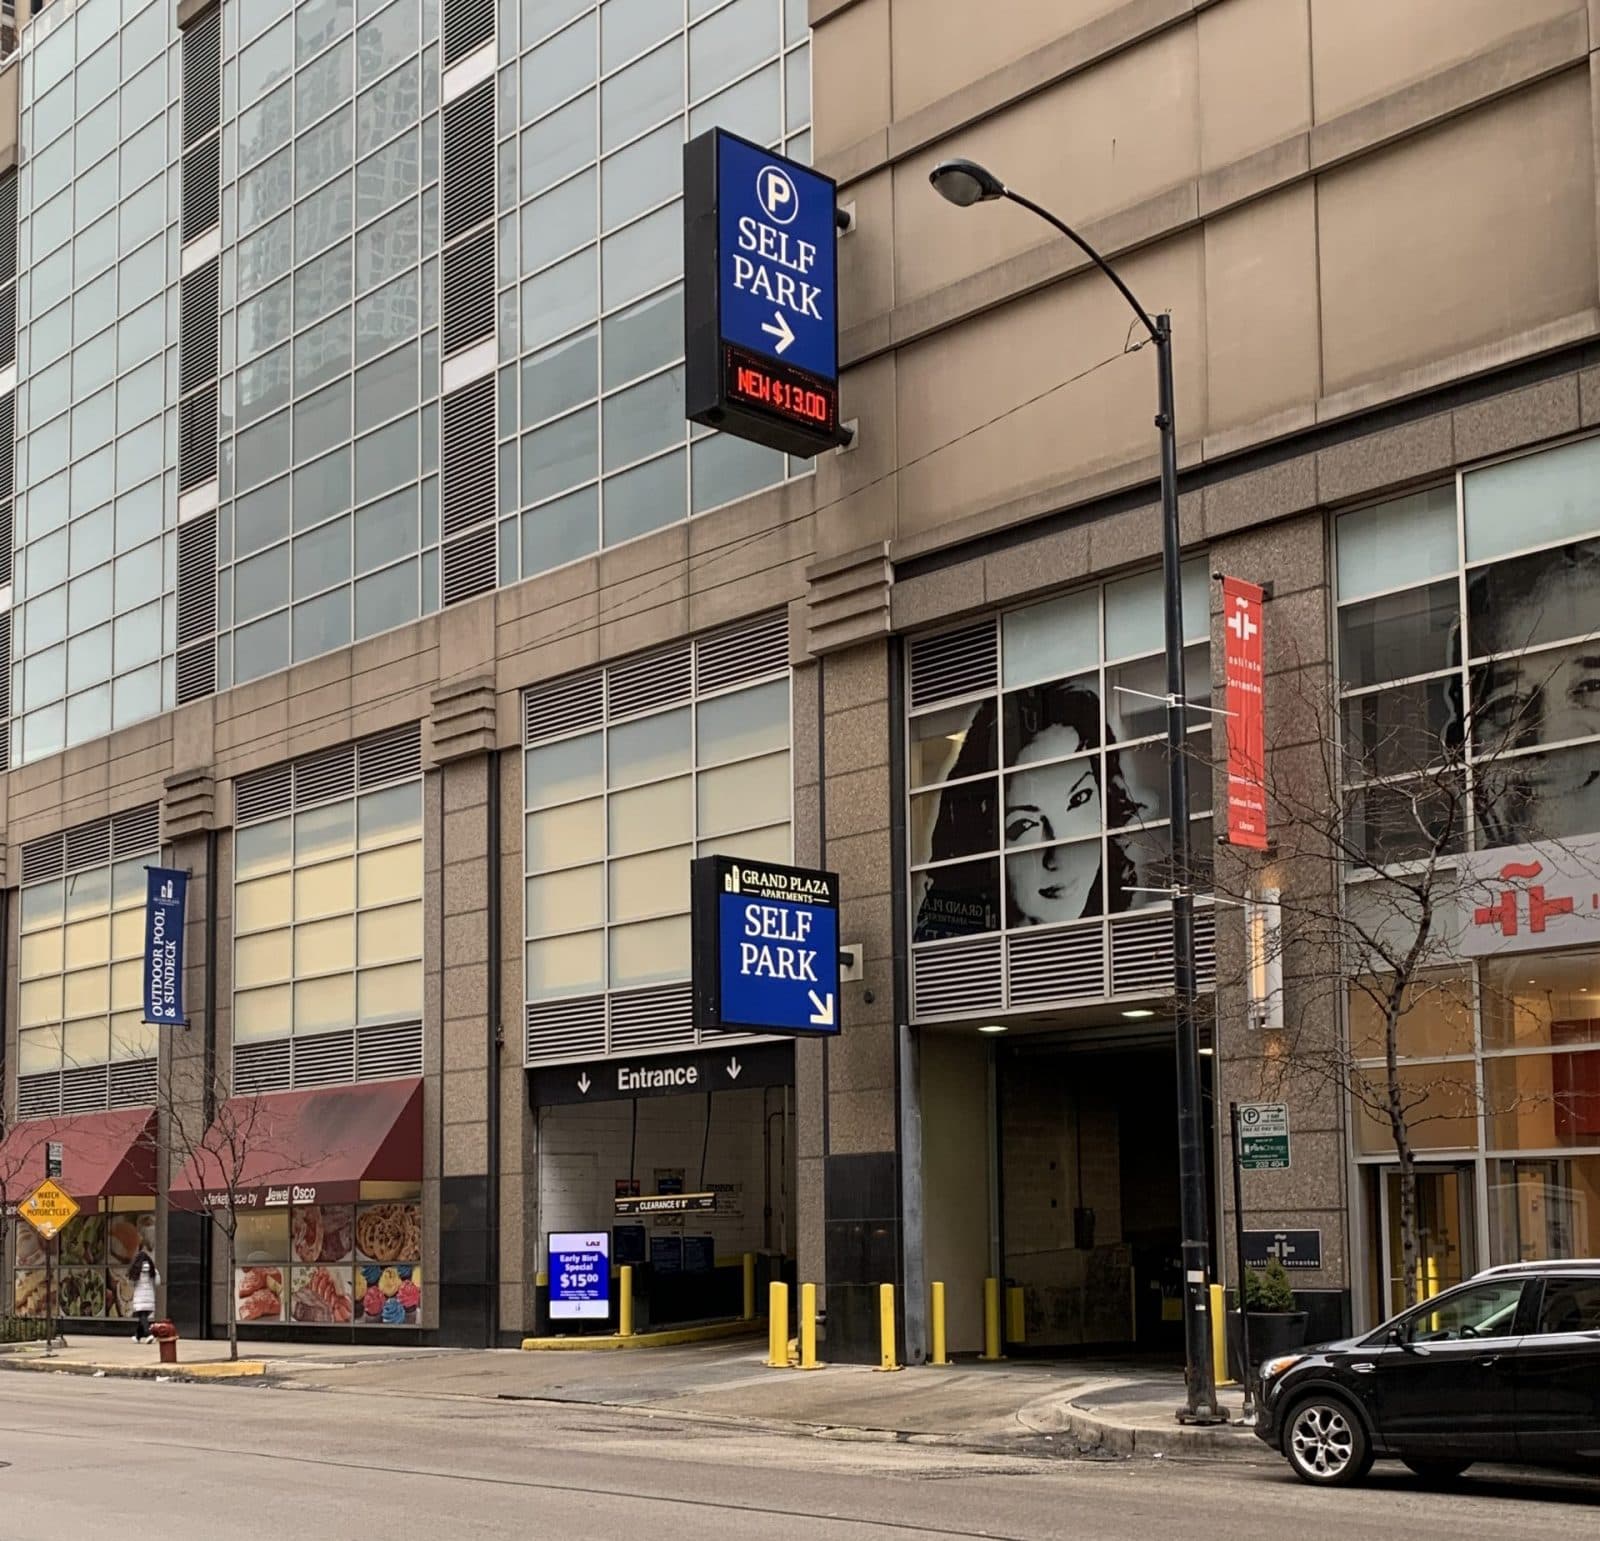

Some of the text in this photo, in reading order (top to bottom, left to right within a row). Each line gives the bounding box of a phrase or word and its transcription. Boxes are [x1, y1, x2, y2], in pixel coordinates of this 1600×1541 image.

[768, 173, 791, 212] P
[738, 216, 816, 274] SELF
[732, 254, 823, 321] PARK
[738, 366, 826, 421] NEW $13.00
[742, 869, 830, 896] GRAND PLAZA
[760, 888, 814, 904] APARTMENTS
[744, 904, 813, 942] SELF
[151, 908, 166, 1017] OUTDOOR POOL
[740, 942, 818, 982] PARK
[164, 940, 177, 1018] & SUNDECK
[617, 1066, 698, 1090] Entrance
[38, 1191, 60, 1199] WATCH
[42, 1200, 55, 1208] FOR
[248, 1192, 258, 1206] by
[265, 1186, 290, 1201] Jewel
[292, 1185, 316, 1200] Osco
[639, 1200, 675, 1210] CLEARANCE
[27, 1208, 70, 1216] MOTORCYCLES
[560, 1253, 599, 1263] Early Bird
[565, 1263, 594, 1273] Special
